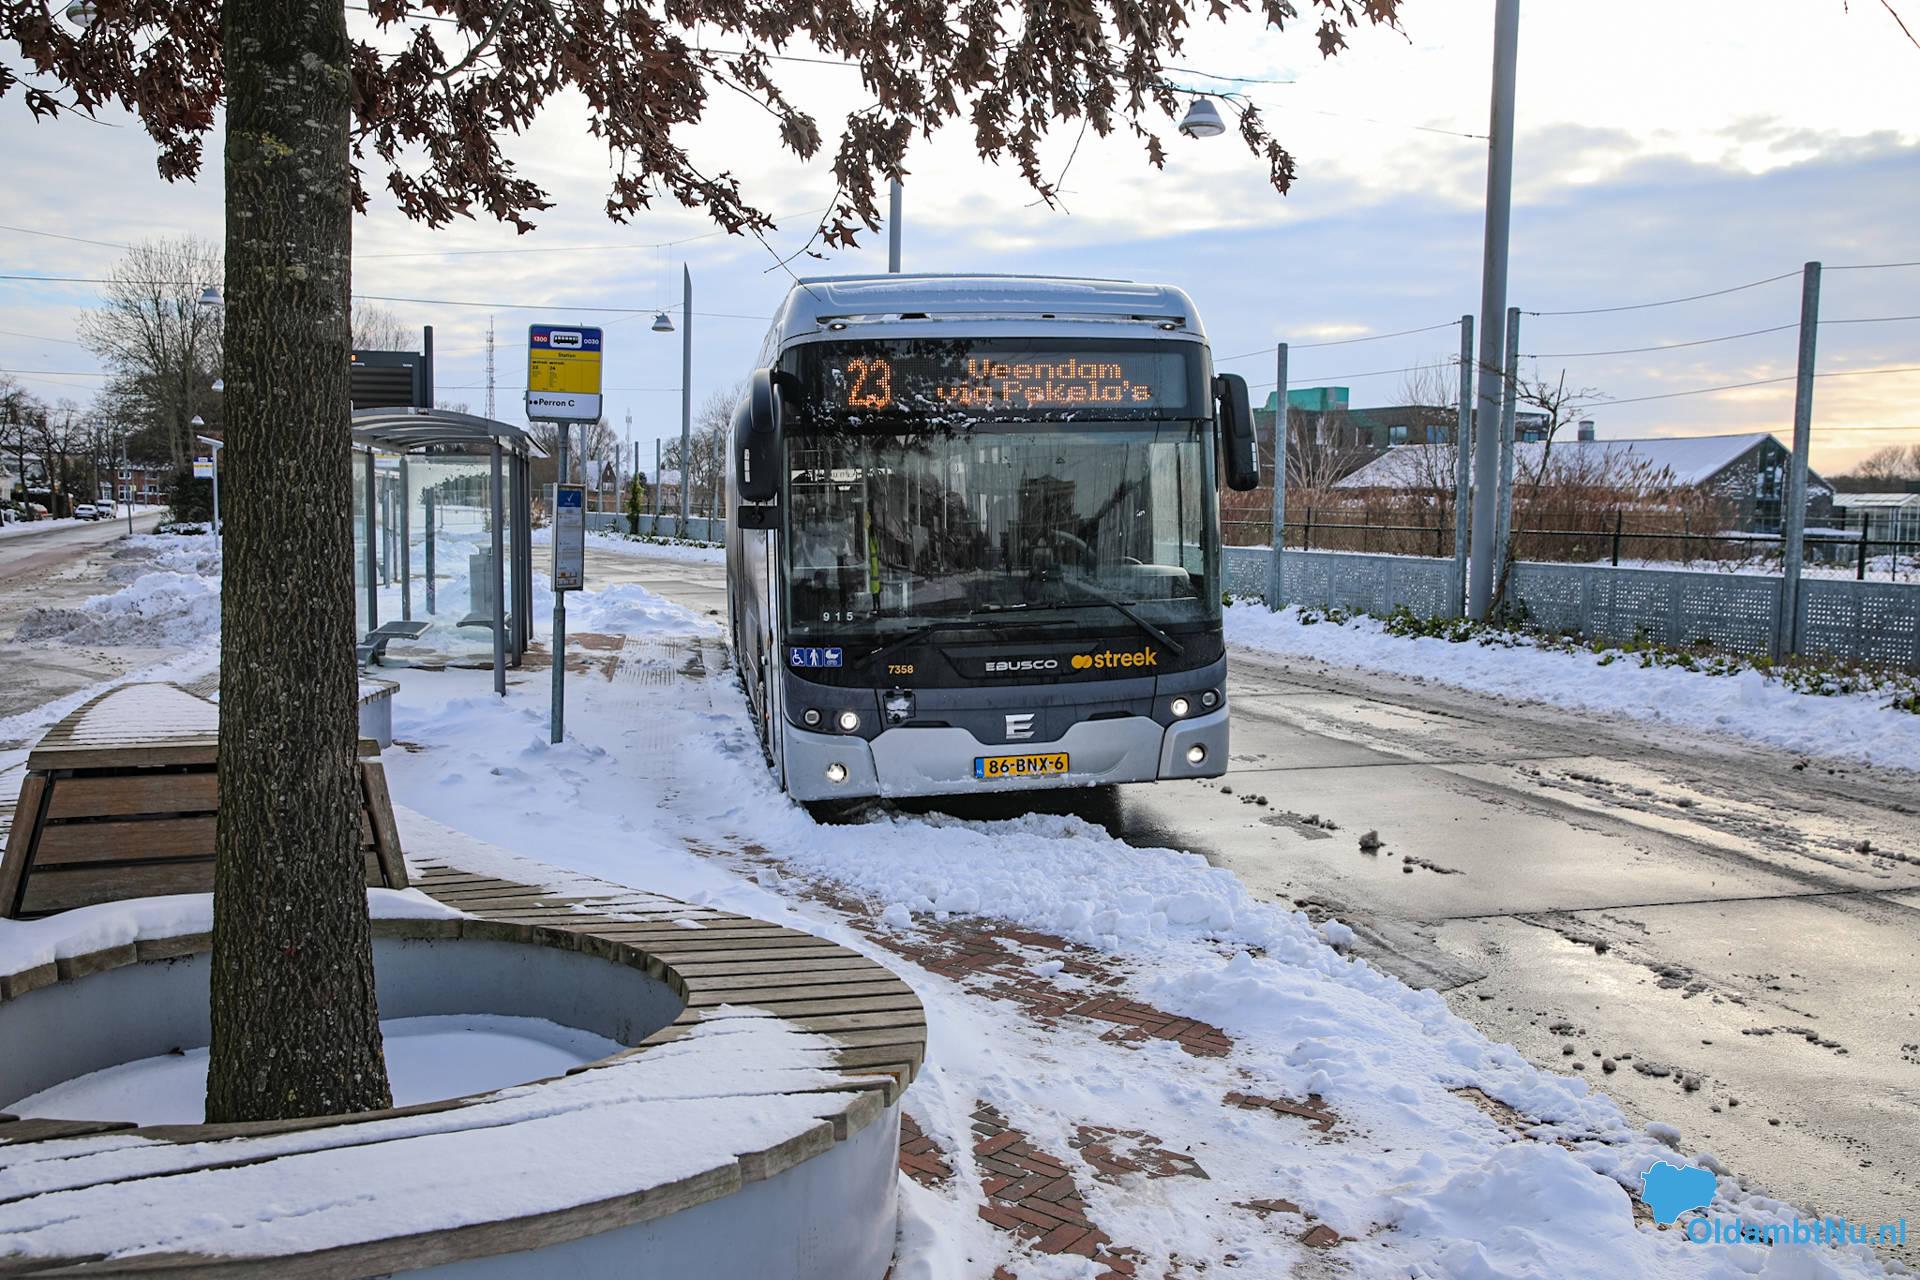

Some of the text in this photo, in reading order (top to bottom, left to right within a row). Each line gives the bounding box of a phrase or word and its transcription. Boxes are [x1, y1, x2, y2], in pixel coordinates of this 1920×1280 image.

[967, 358, 1122, 379] Veendam
[847, 358, 891, 407] 23
[937, 380, 1152, 404] via Pekela's
[539, 398, 575, 408] Perron C
[985, 658, 1059, 672] EBUSCO
[1094, 646, 1158, 668] streek
[888, 664, 914, 674] 7358
[988, 755, 1065, 774] 86-BNX-6
